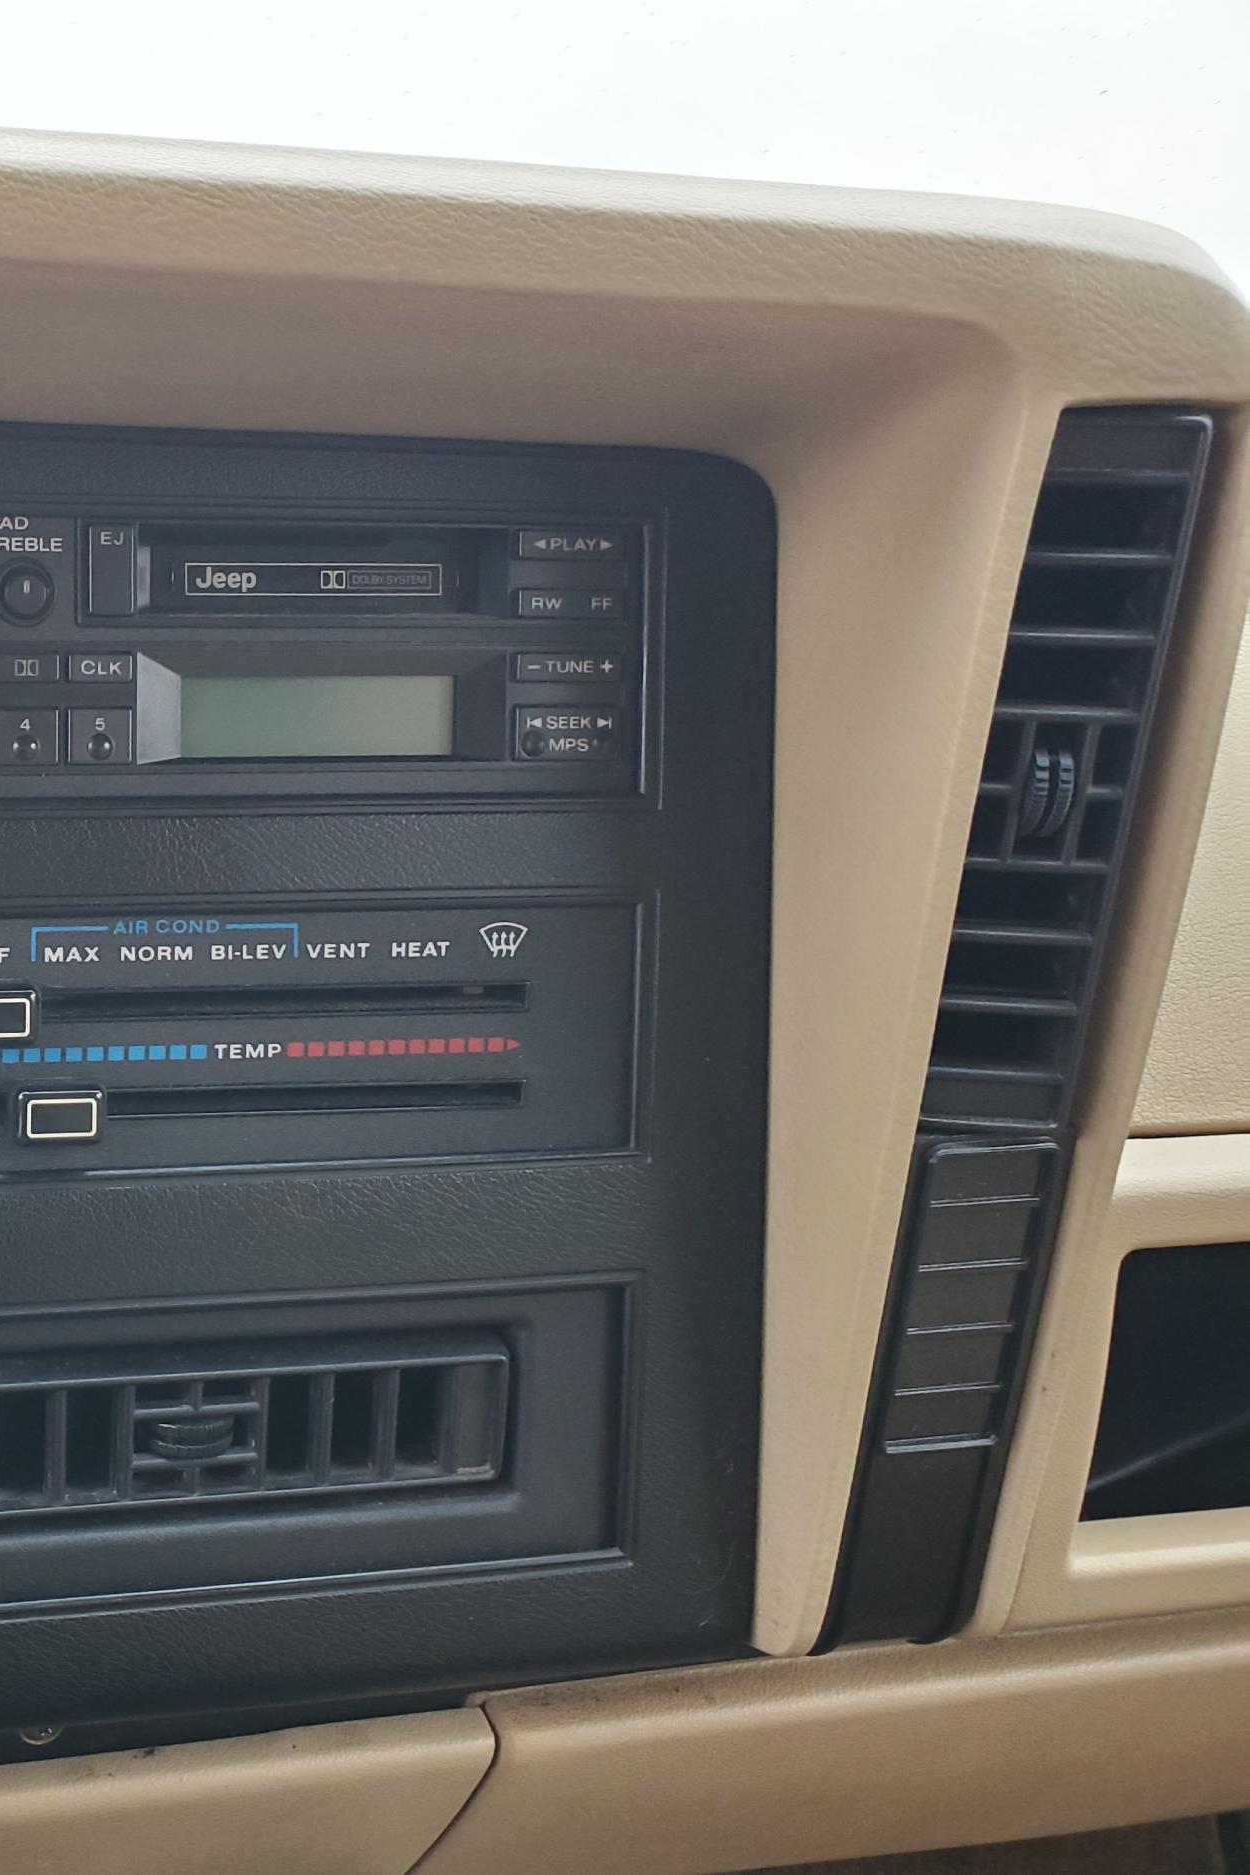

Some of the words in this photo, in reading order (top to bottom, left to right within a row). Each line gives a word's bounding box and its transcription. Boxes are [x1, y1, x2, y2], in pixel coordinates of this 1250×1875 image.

[99, 531, 124, 546] EJ
[550, 537, 598, 552] PLAY
[195, 566, 257, 592] Jeep
[531, 597, 562, 611] RW
[591, 597, 613, 611] FF
[80, 661, 122, 675] CLK
[546, 660, 594, 673] TUNE
[20, 719, 31, 732] 4
[95, 718, 106, 731] 5
[546, 716, 591, 730] SEEK
[549, 737, 589, 752] MPS
[113, 920, 148, 935] AIR
[155, 920, 220, 935] COND
[44, 946, 100, 963] MAX
[120, 945, 194, 962] NORM
[211, 943, 287, 961] BI-LEV
[307, 942, 370, 959] VENT
[391, 941, 451, 958] HEAT
[214, 1043, 283, 1060] TEMP
